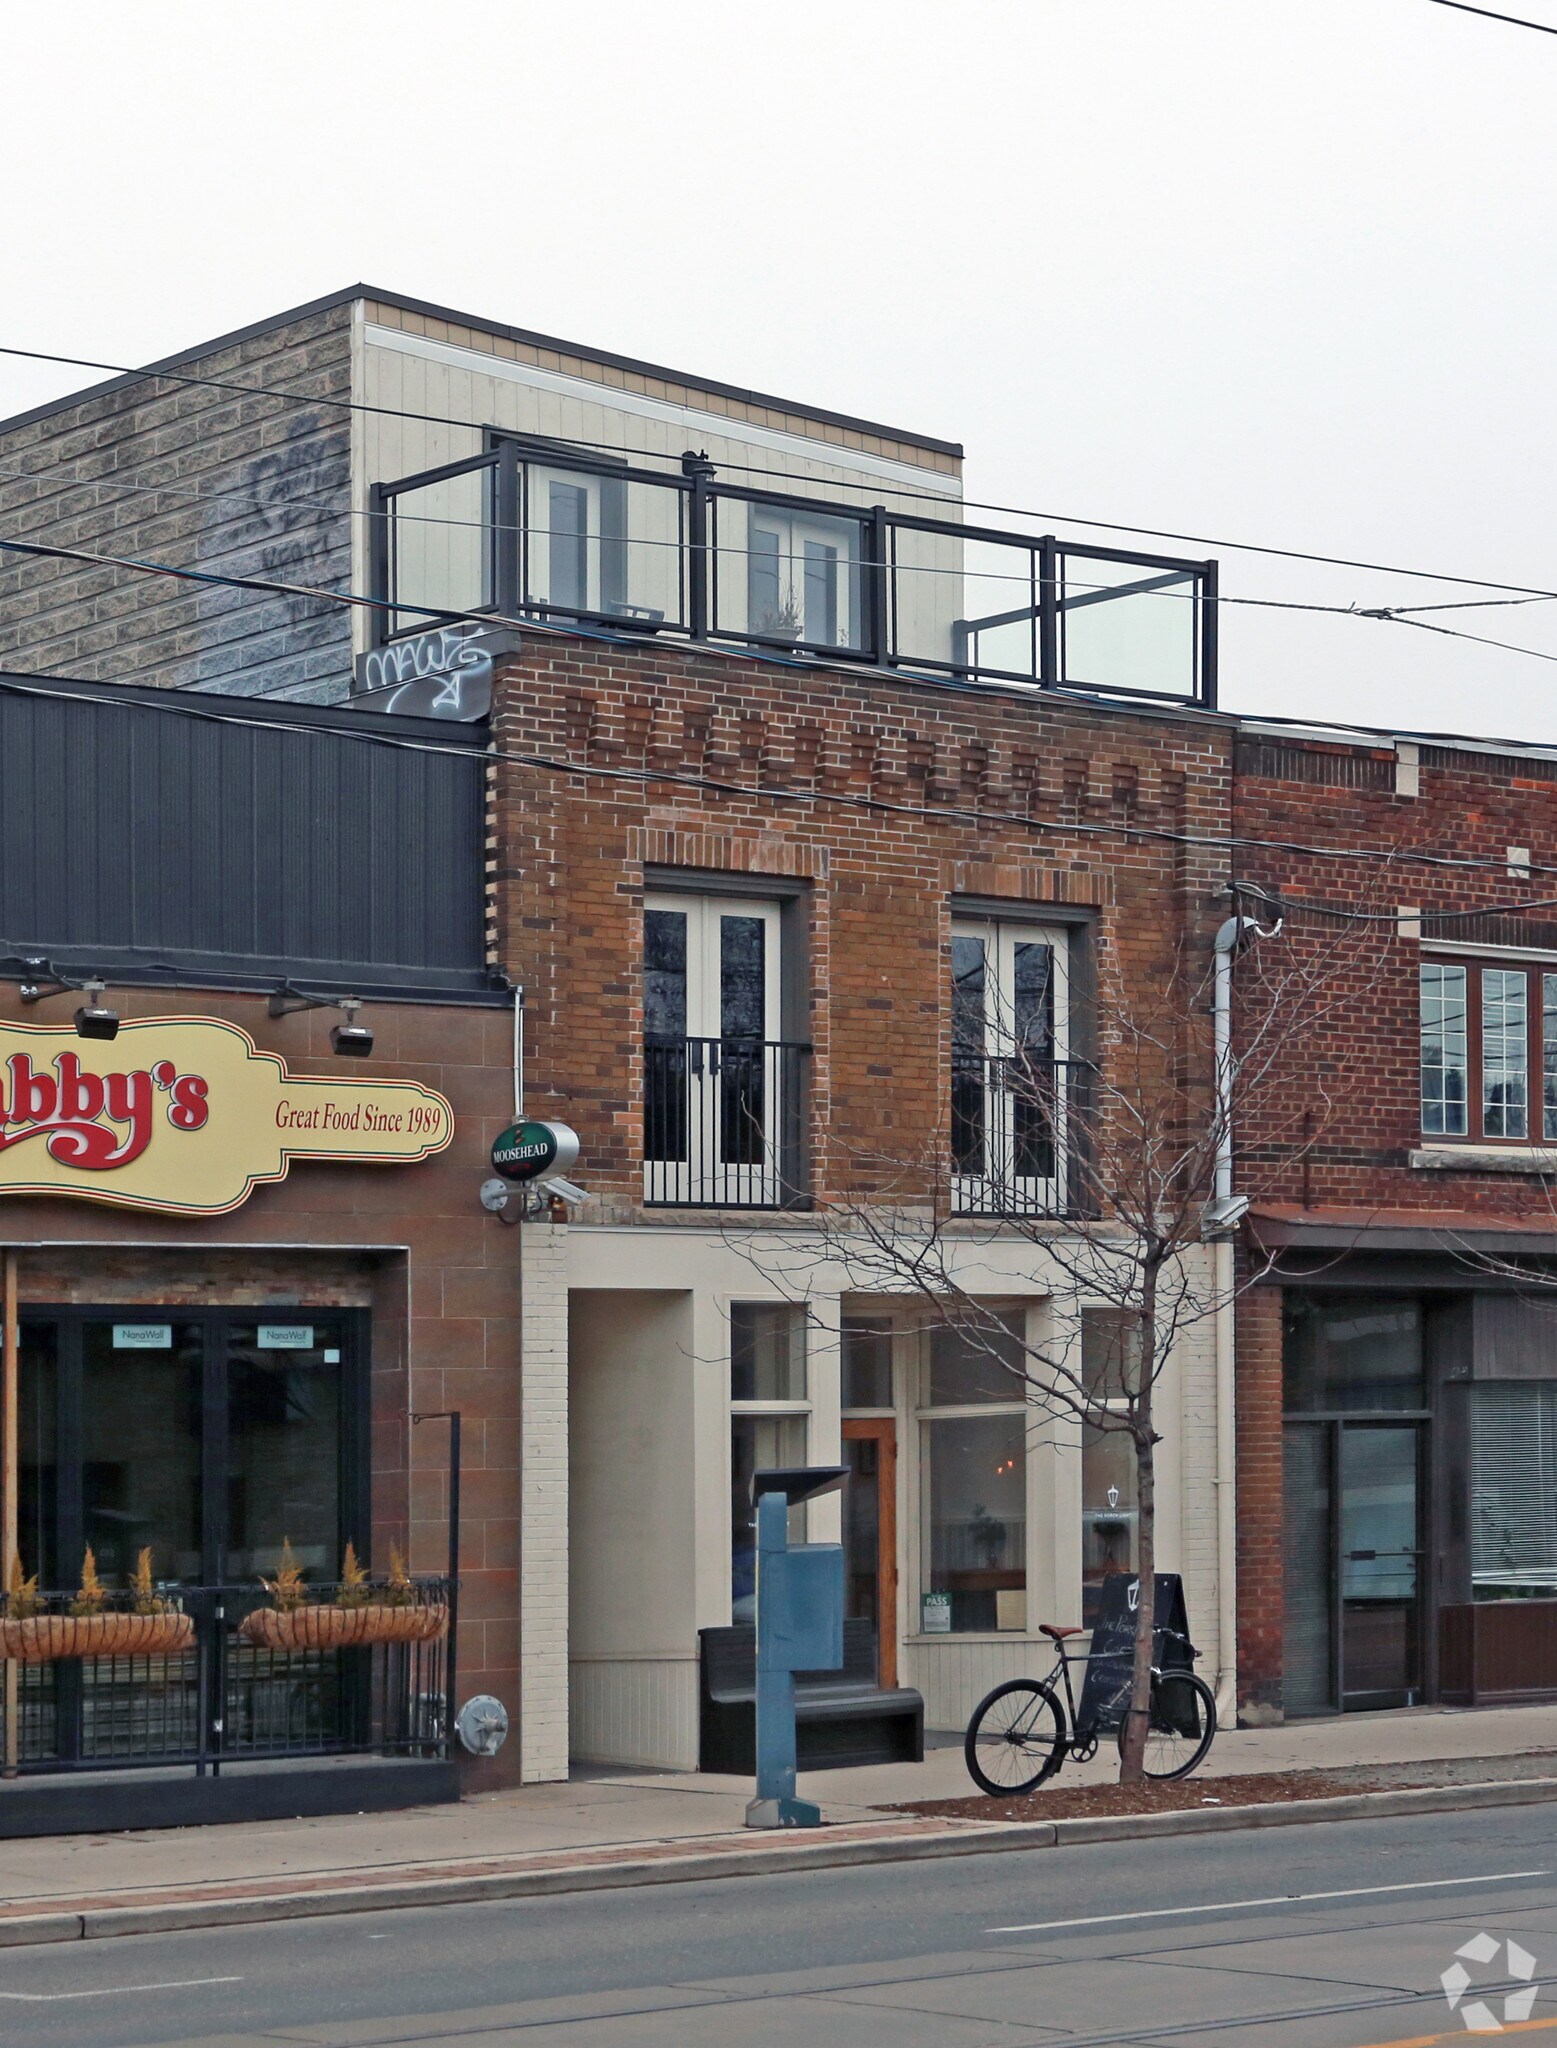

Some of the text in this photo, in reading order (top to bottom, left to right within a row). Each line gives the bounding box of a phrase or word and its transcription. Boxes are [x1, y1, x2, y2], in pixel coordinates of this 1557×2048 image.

[0, 1052, 209, 1170] bby's
[275, 1100, 441, 1136] Great Food Since 1989
[493, 1142, 549, 1163] MOOSEHEAD
[122, 1330, 164, 1339] NanaWall
[266, 1329, 307, 1340] NanaWall
[926, 1597, 947, 1606] PASS
